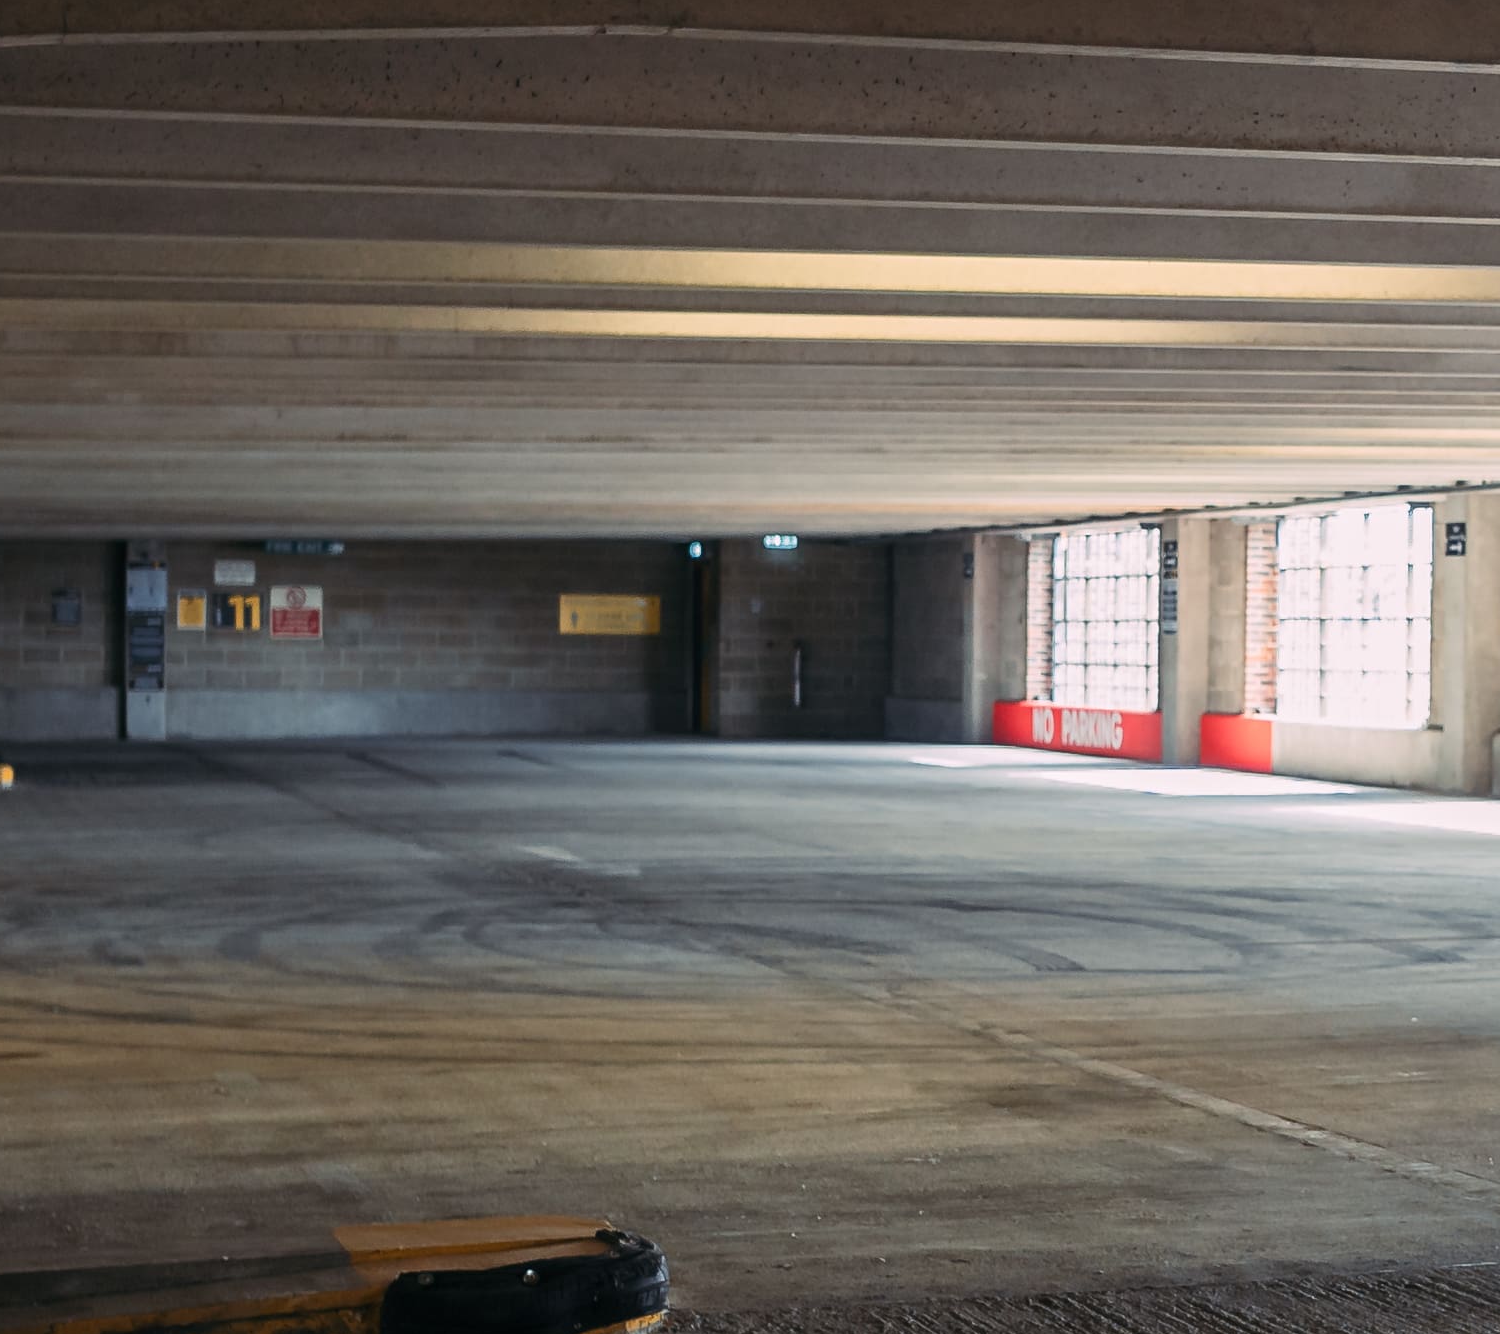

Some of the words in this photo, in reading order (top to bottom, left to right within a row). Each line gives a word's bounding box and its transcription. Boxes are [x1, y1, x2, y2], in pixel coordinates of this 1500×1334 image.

[228, 595, 261, 631] 11
[1032, 707, 1055, 744] NO
[1061, 708, 1124, 750] PARKING
